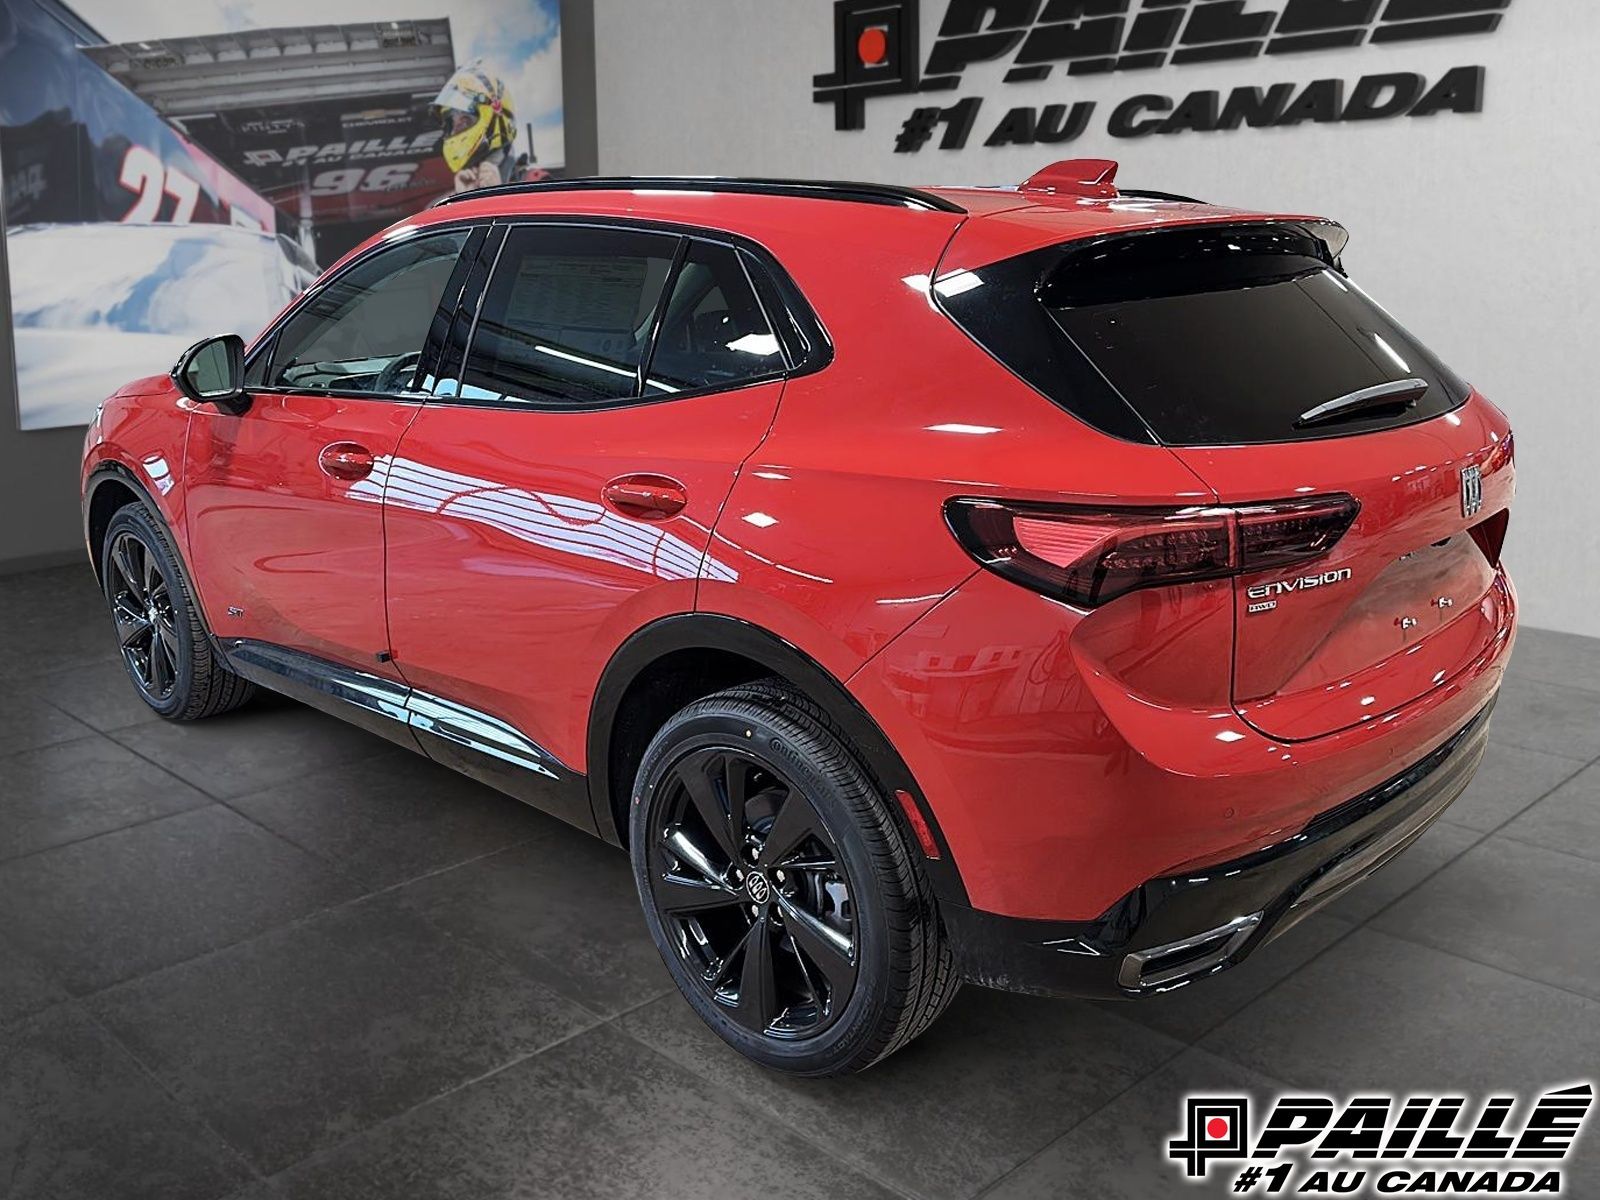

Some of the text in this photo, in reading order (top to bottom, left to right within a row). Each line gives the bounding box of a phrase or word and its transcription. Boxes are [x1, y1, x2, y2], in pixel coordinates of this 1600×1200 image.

[894, 65, 1486, 153] #1 AU CANADA
[119, 144, 200, 223] 27
[311, 163, 419, 196] 96
[314, 155, 343, 164] AU
[350, 147, 434, 160] CANADA
